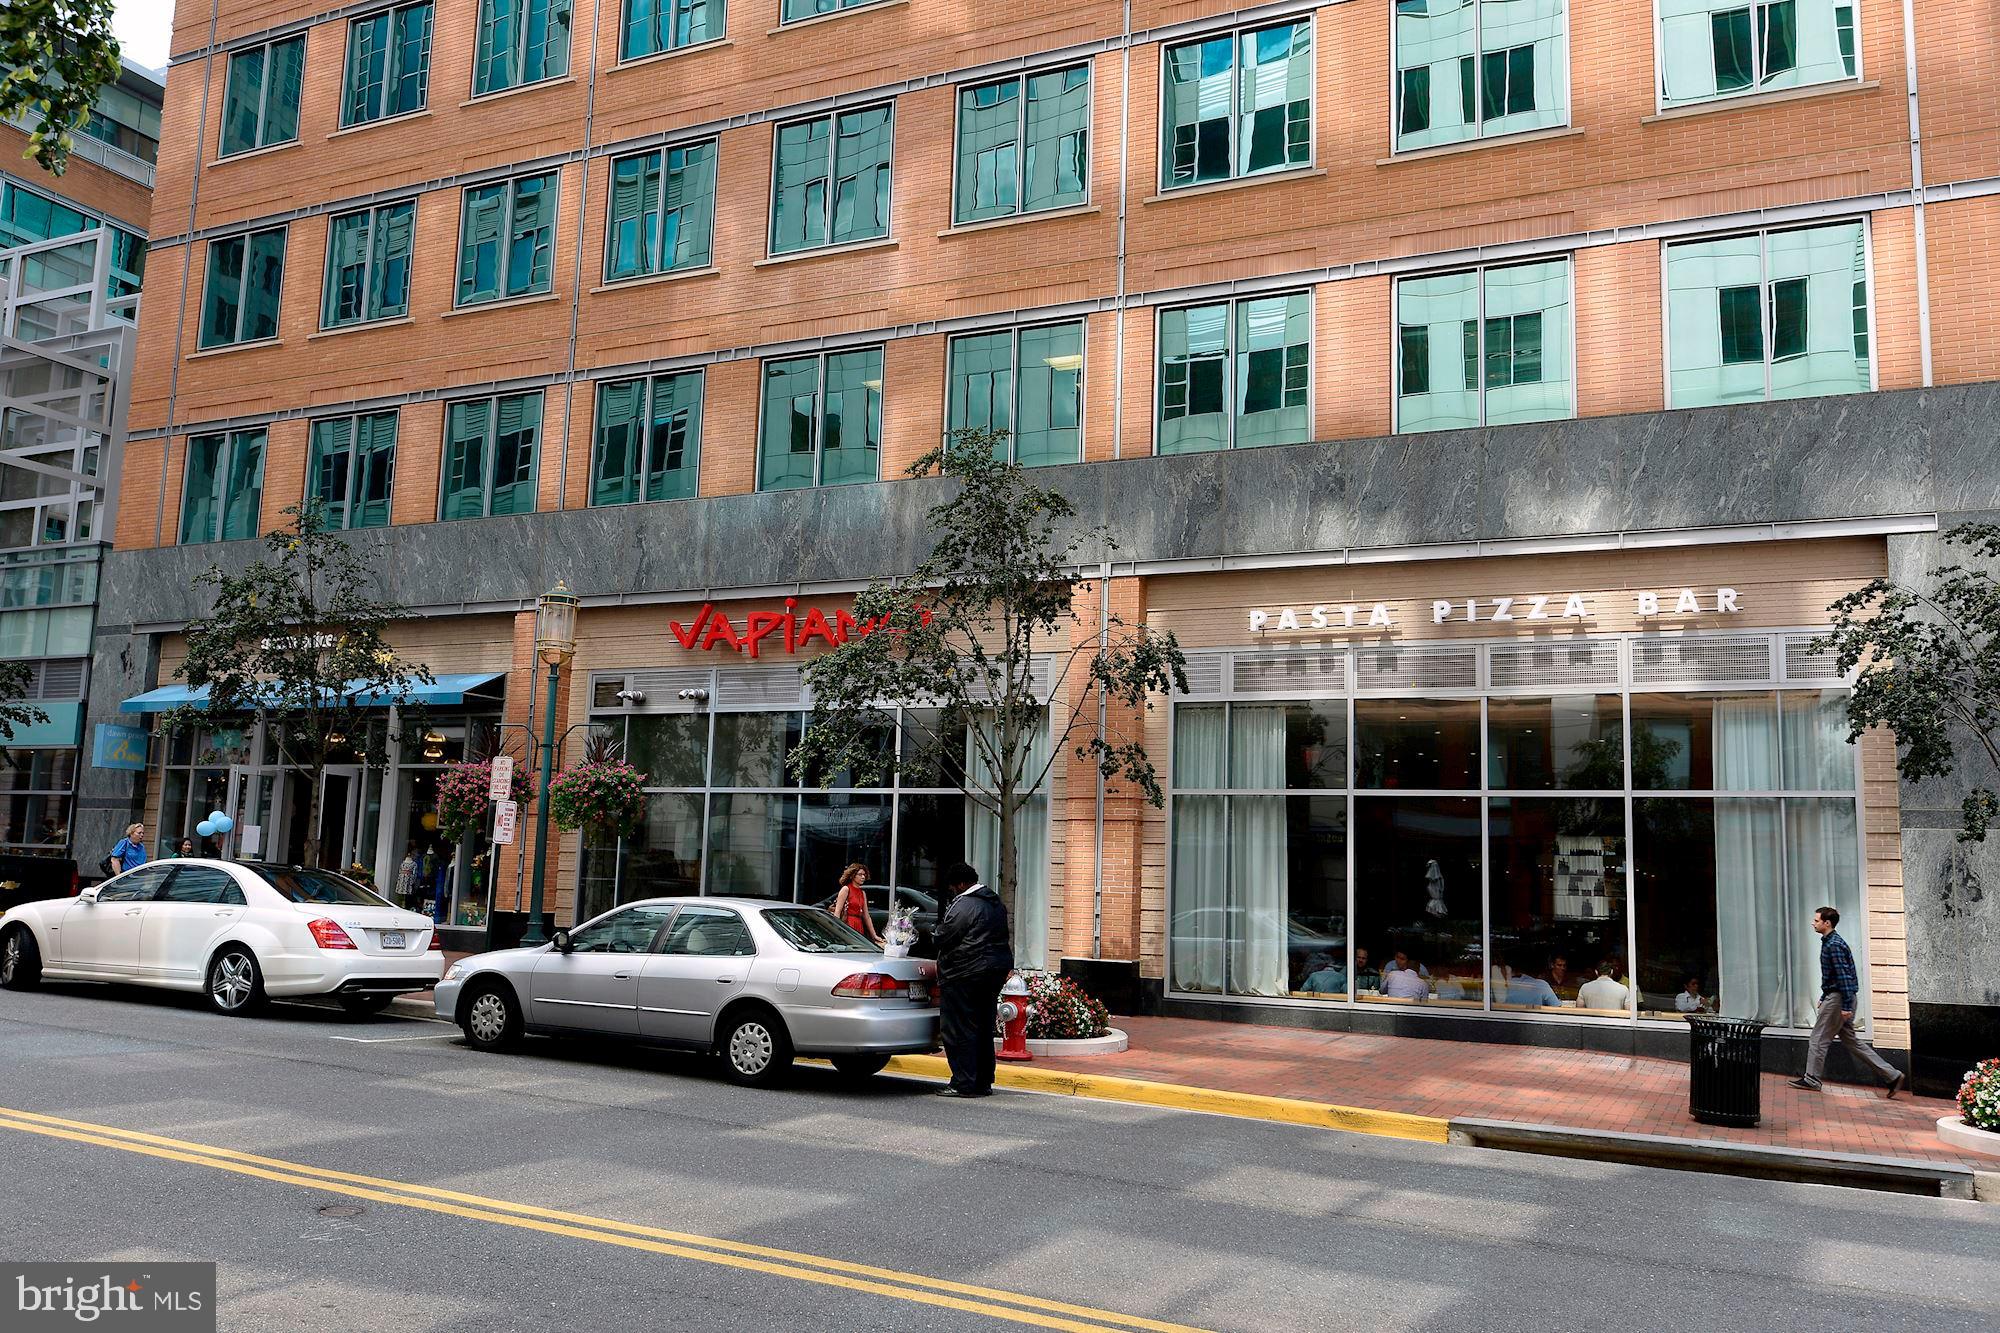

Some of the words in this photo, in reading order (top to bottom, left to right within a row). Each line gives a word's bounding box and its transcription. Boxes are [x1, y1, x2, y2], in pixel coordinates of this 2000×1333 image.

[669, 597, 932, 658] VAPIAN
[1249, 604, 1391, 632] PASTA
[1432, 595, 1588, 624] PIZZA
[1638, 588, 1738, 617] BAR
